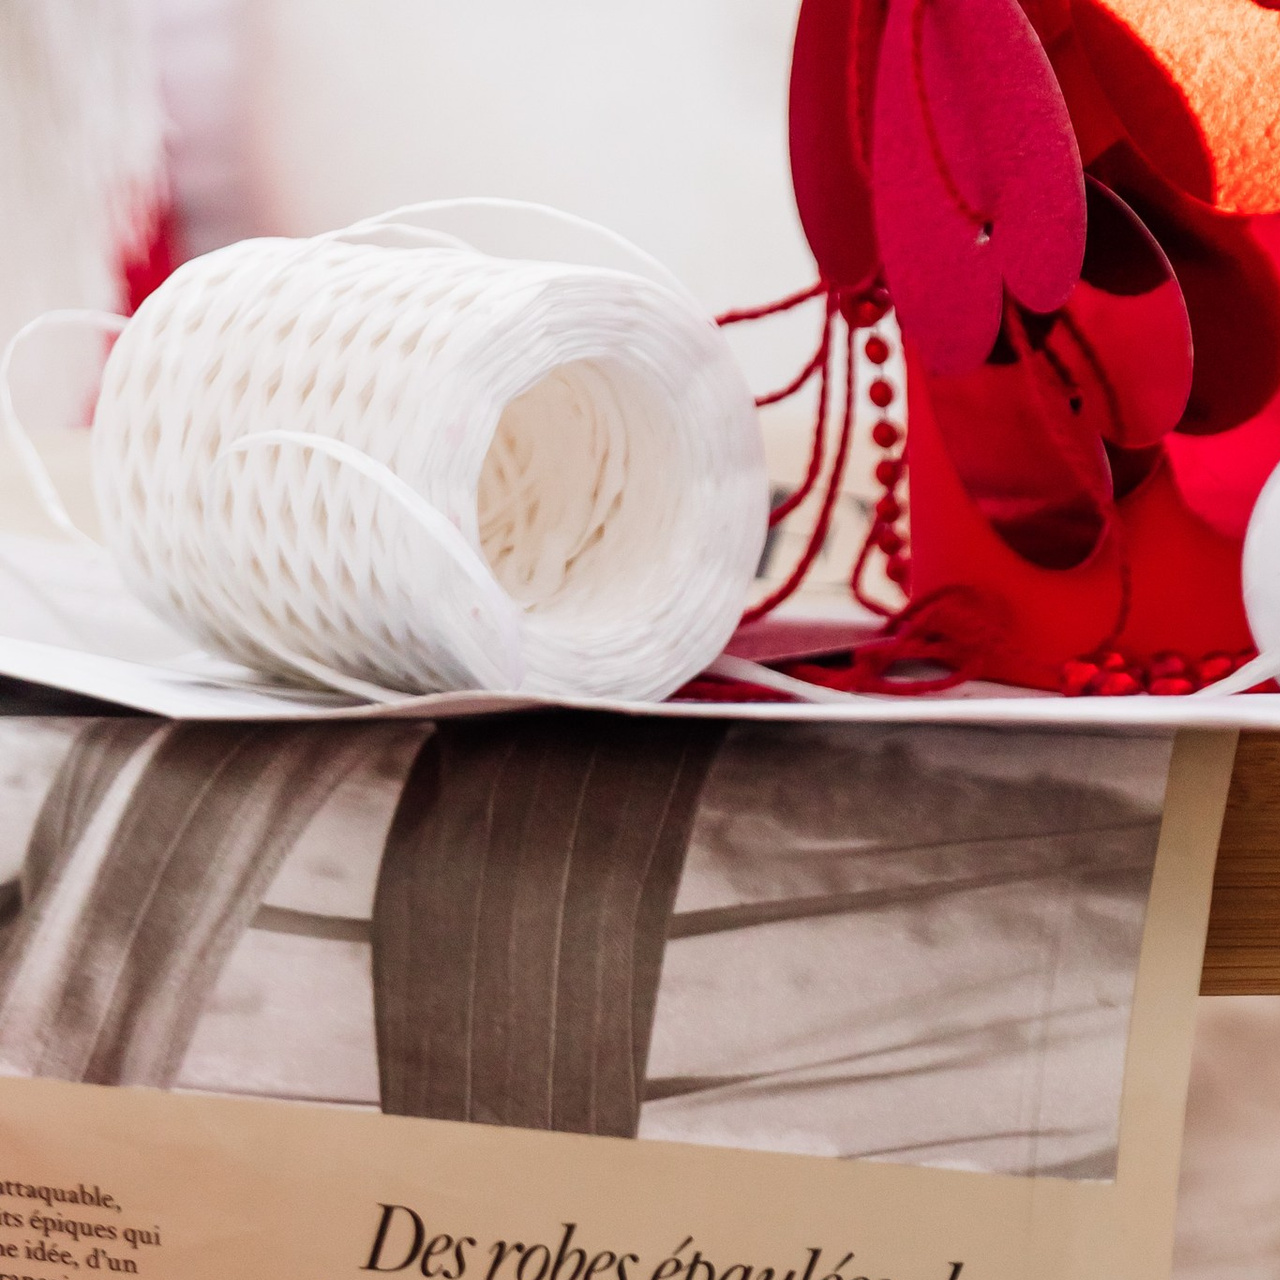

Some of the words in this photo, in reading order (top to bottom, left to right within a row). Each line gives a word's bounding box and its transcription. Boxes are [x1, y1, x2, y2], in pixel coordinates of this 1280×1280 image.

[0, 1210, 24, 1228] ts
[29, 1209, 117, 1241] épiques
[123, 1225, 161, 1249] qui
[358, 1202, 477, 1280] Des
[25, 1239, 79, 1269] idée,
[86, 1247, 138, 1274] d'un
